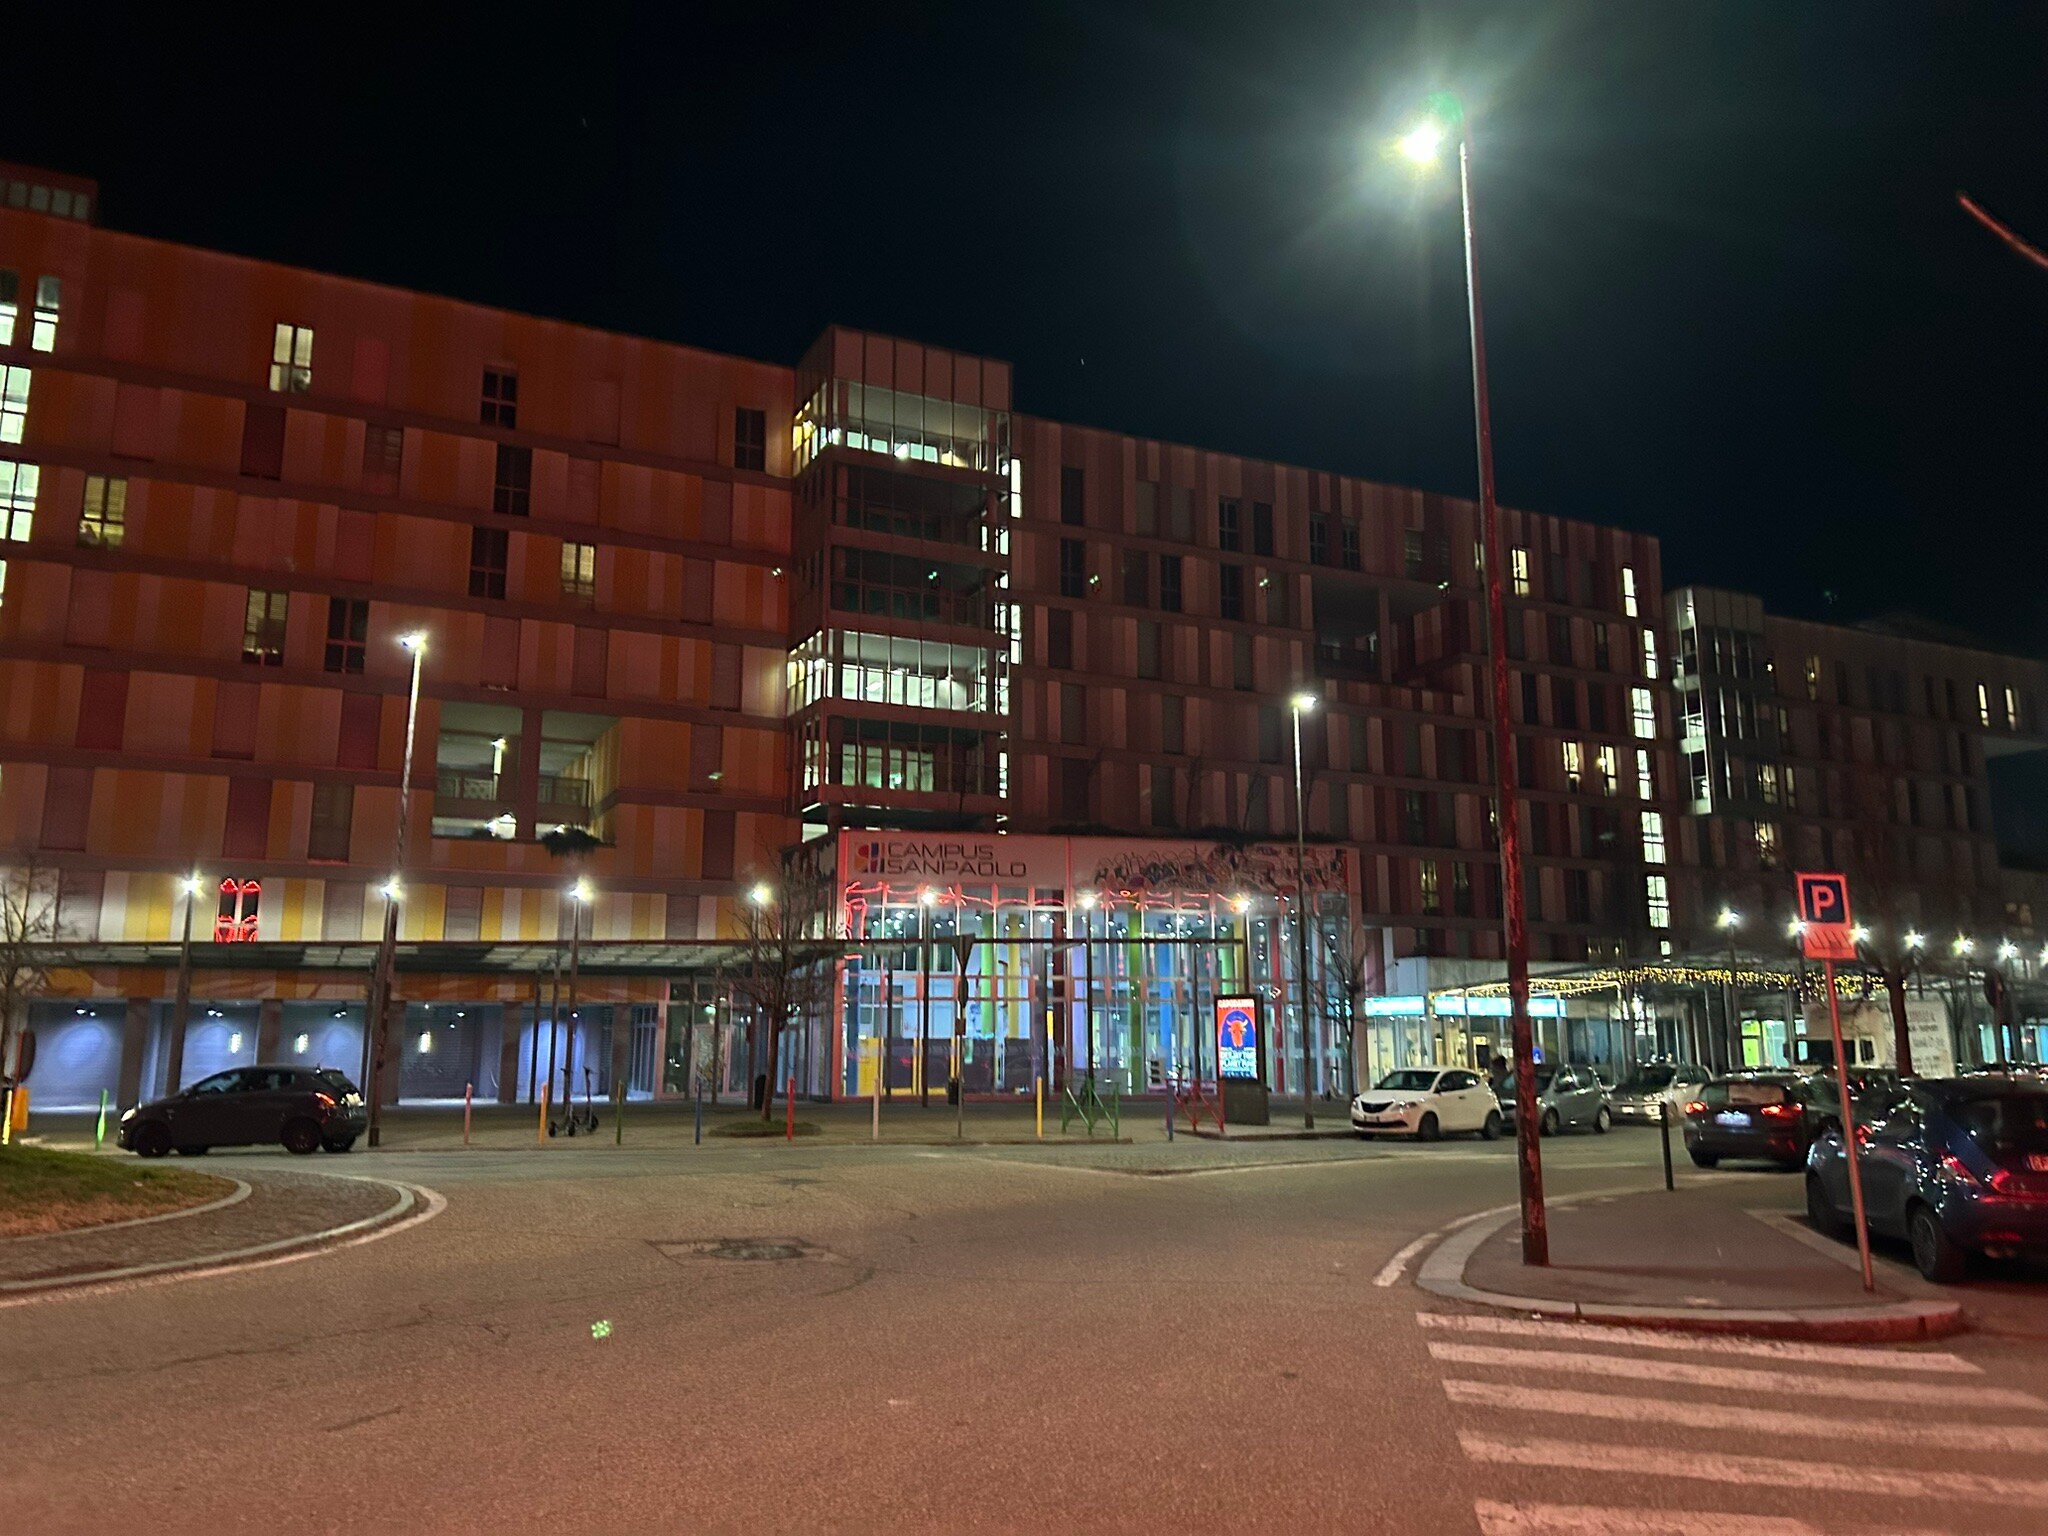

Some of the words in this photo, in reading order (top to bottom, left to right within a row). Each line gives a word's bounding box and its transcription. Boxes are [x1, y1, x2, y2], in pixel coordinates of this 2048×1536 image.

[887, 842, 994, 860] CAMPUS
[887, 859, 1027, 877] SANPAOLO
[1811, 885, 1835, 919] P
